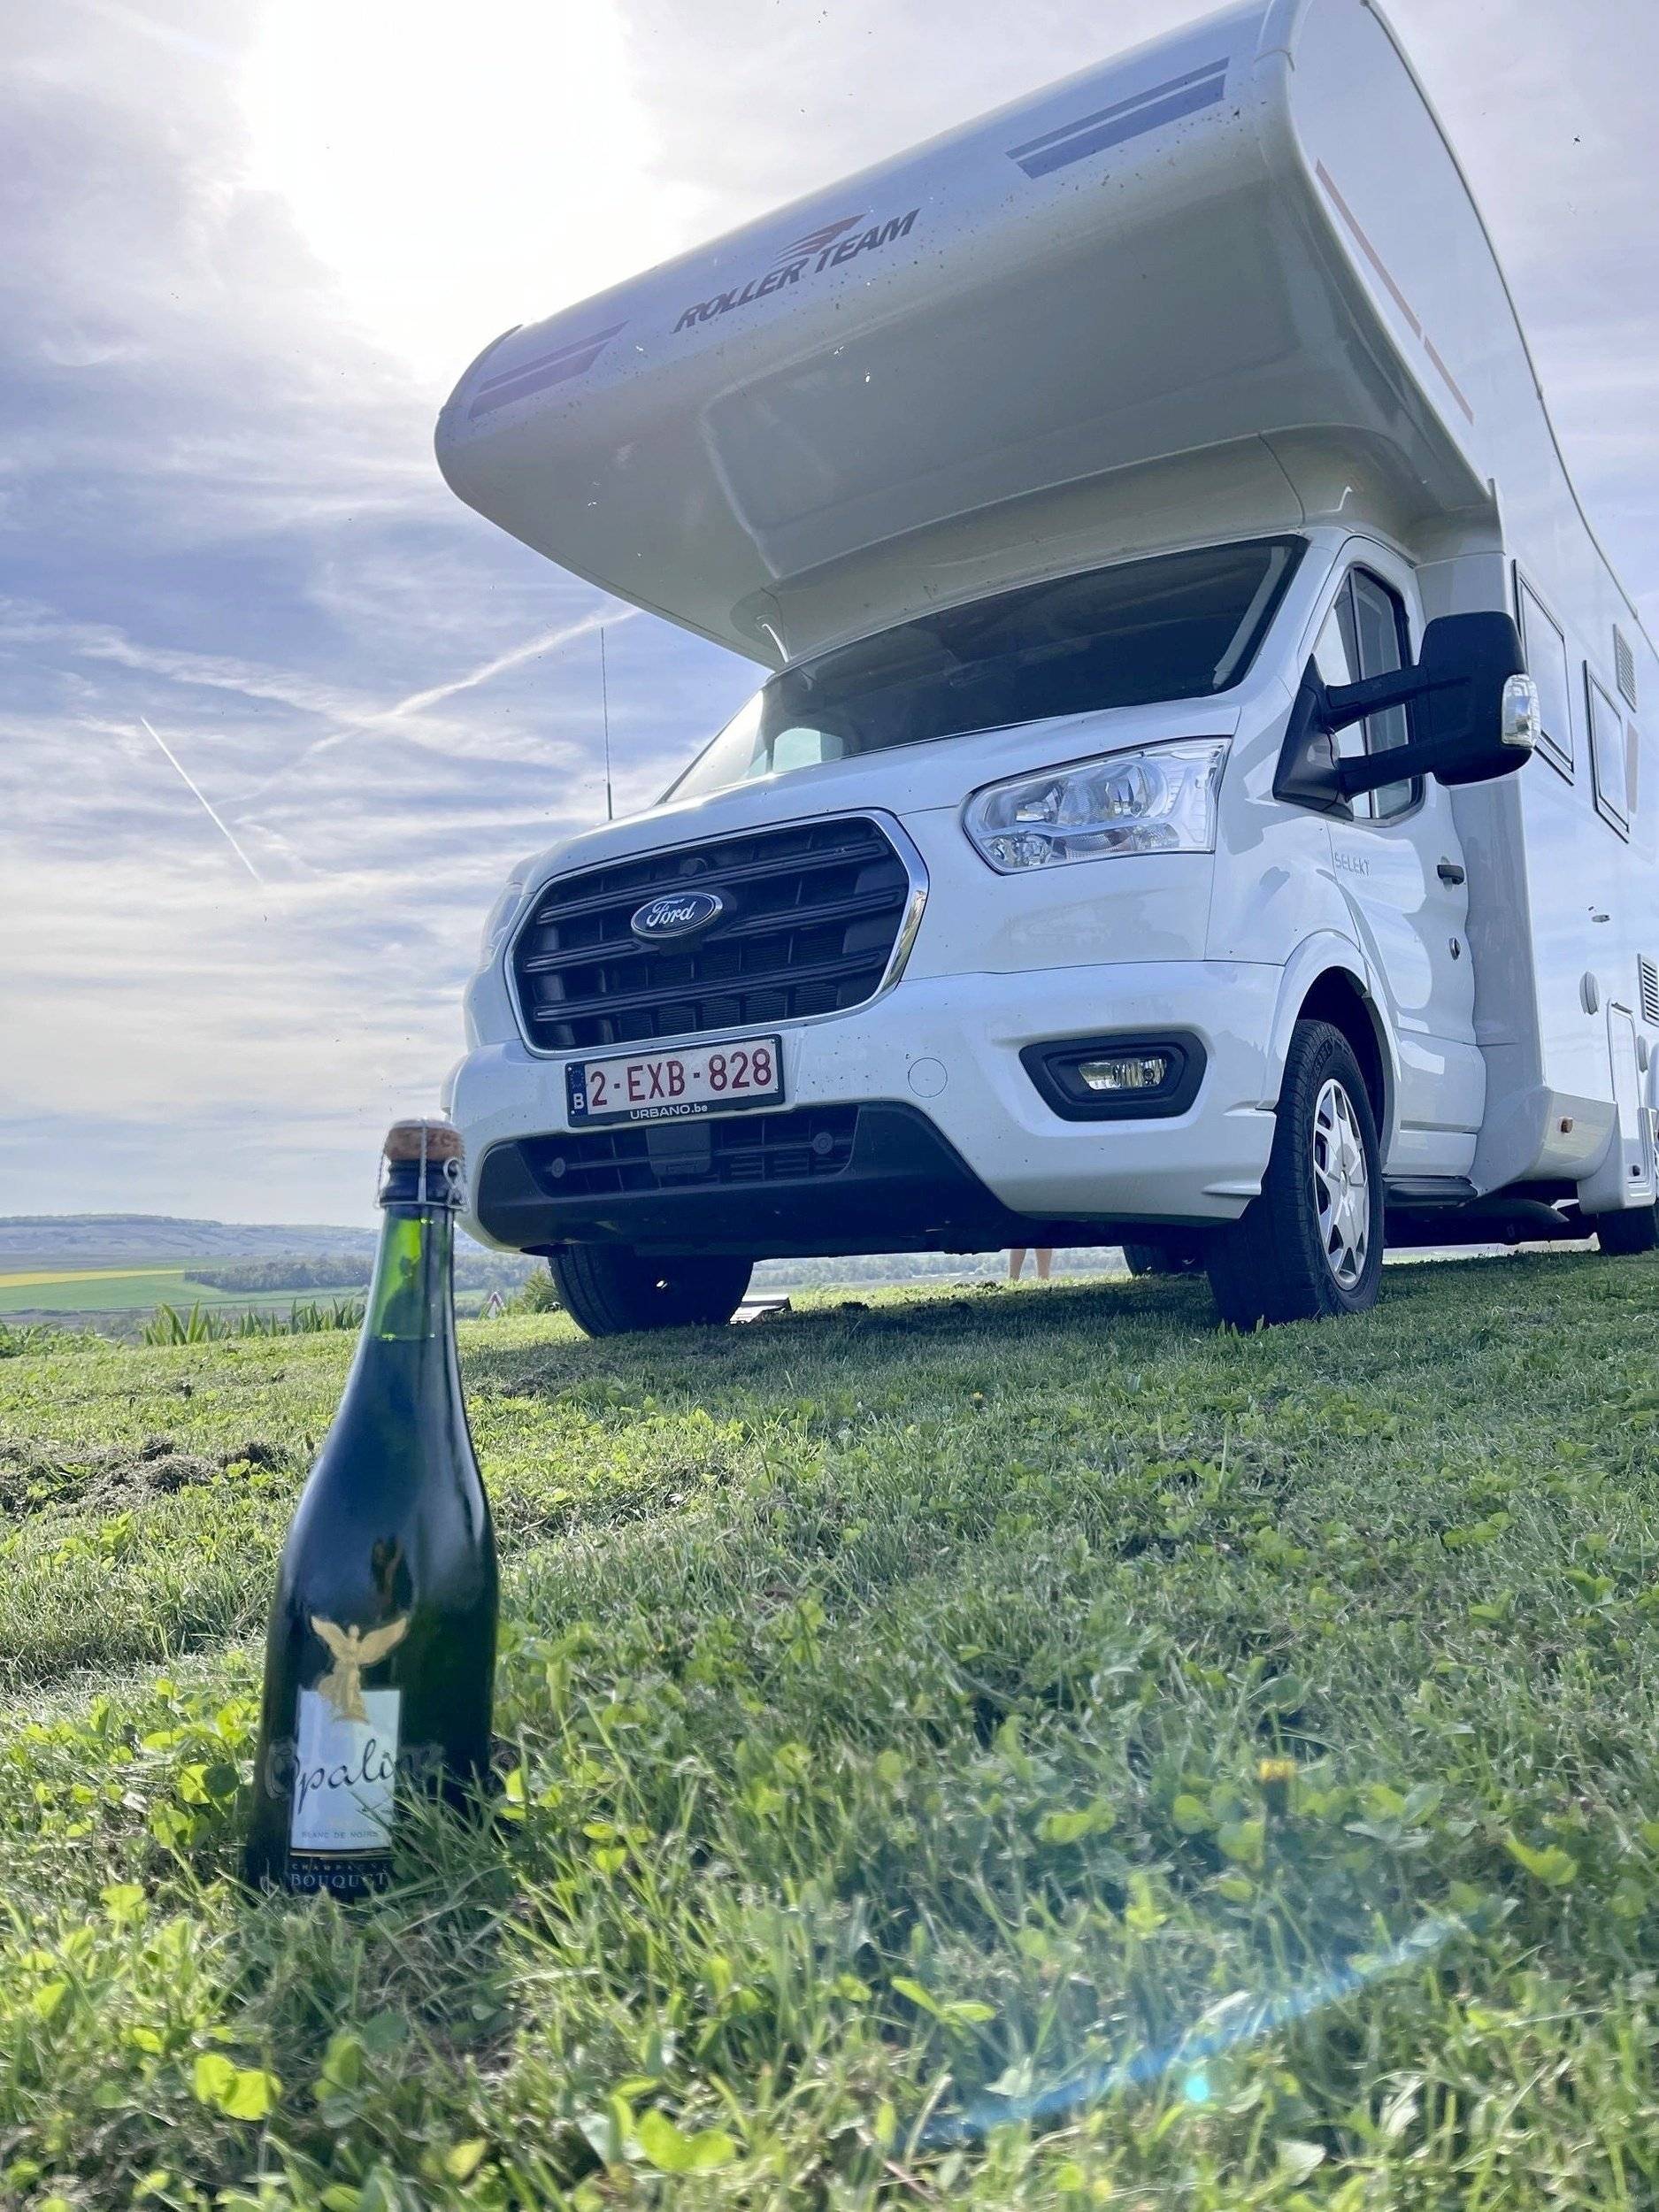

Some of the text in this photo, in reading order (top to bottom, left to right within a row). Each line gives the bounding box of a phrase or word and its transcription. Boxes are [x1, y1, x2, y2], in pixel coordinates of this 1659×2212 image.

[670, 208, 921, 334] ROLLER TEAM
[1334, 852, 1370, 877] SELEKT
[646, 898, 696, 927] Ford
[572, 1093, 585, 1110] B
[630, 1104, 709, 1120] URBANO.be
[290, 1871, 389, 1889] BOUQUT
